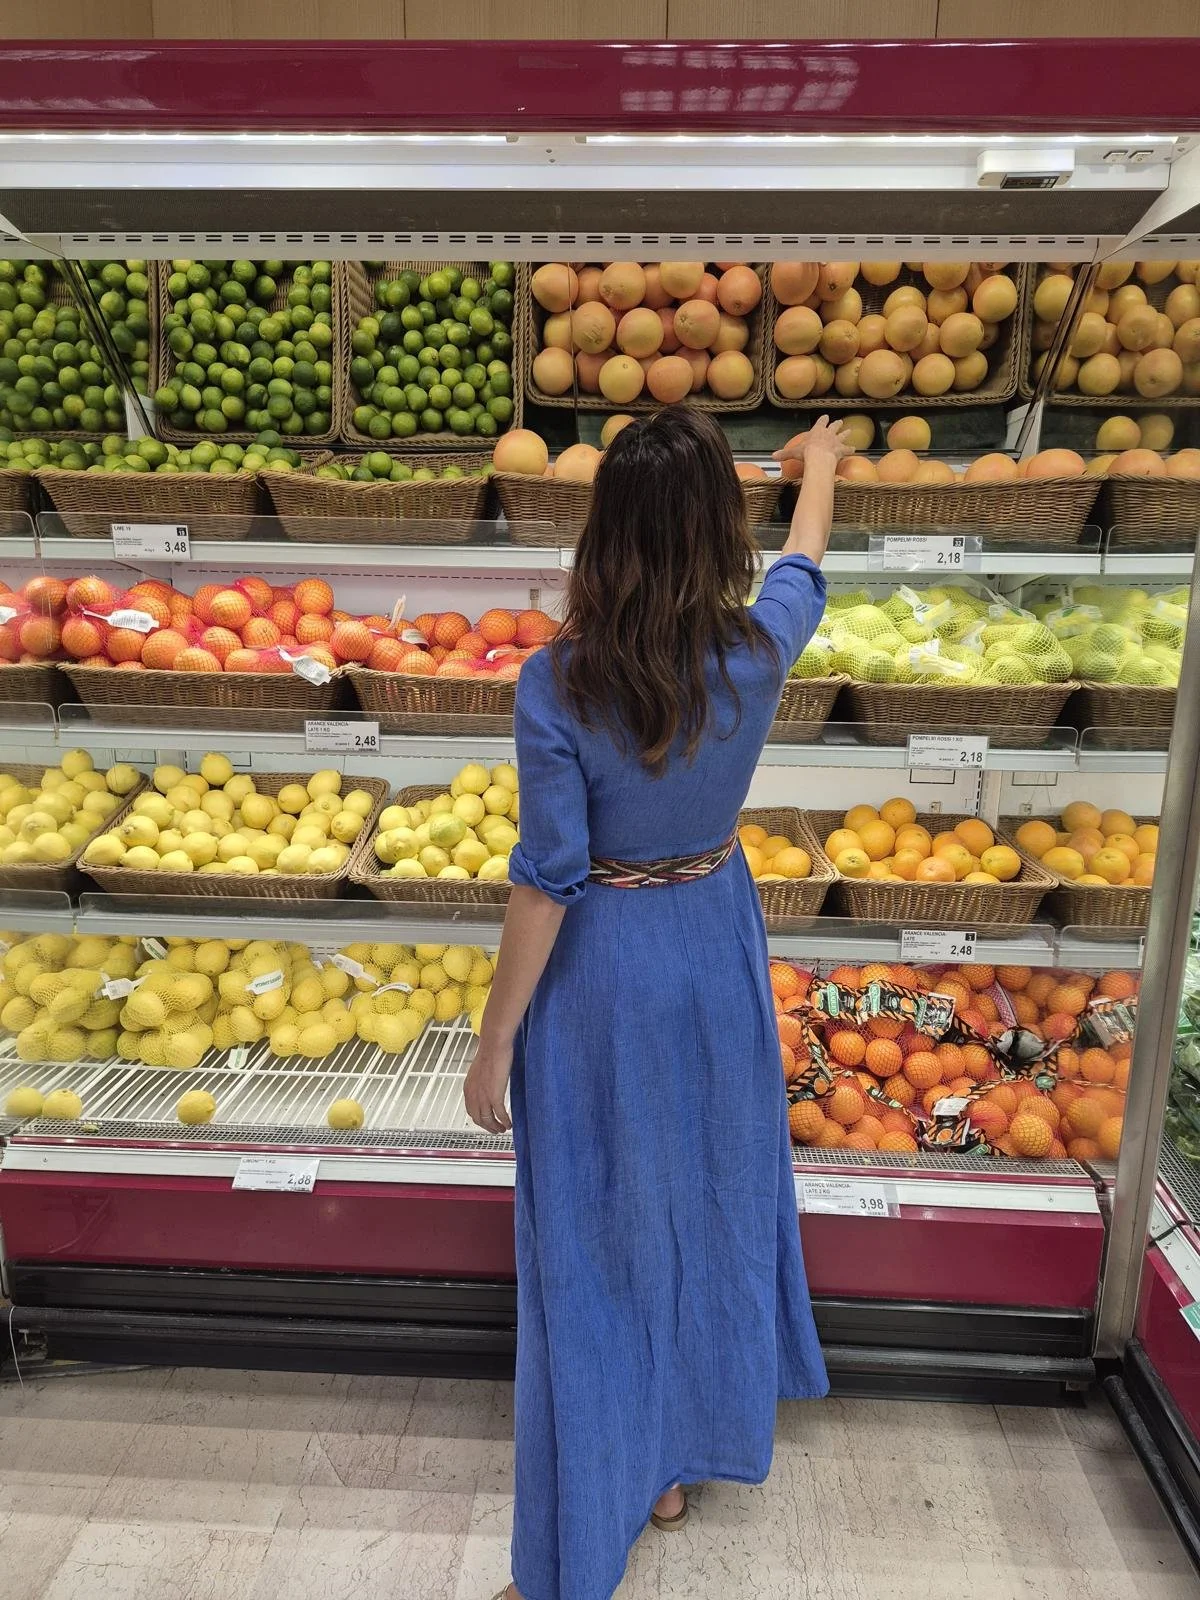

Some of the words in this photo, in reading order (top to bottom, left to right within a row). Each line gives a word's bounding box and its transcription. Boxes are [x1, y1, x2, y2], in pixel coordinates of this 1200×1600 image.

[164, 541, 187, 554] 3,48
[937, 552, 961, 565] 2,18
[355, 735, 376, 747] 2,48
[960, 751, 983, 764] 2,18
[950, 945, 973, 957] 2,48
[287, 1173, 312, 1187] 2,88
[859, 1197, 885, 1211] 3,98
